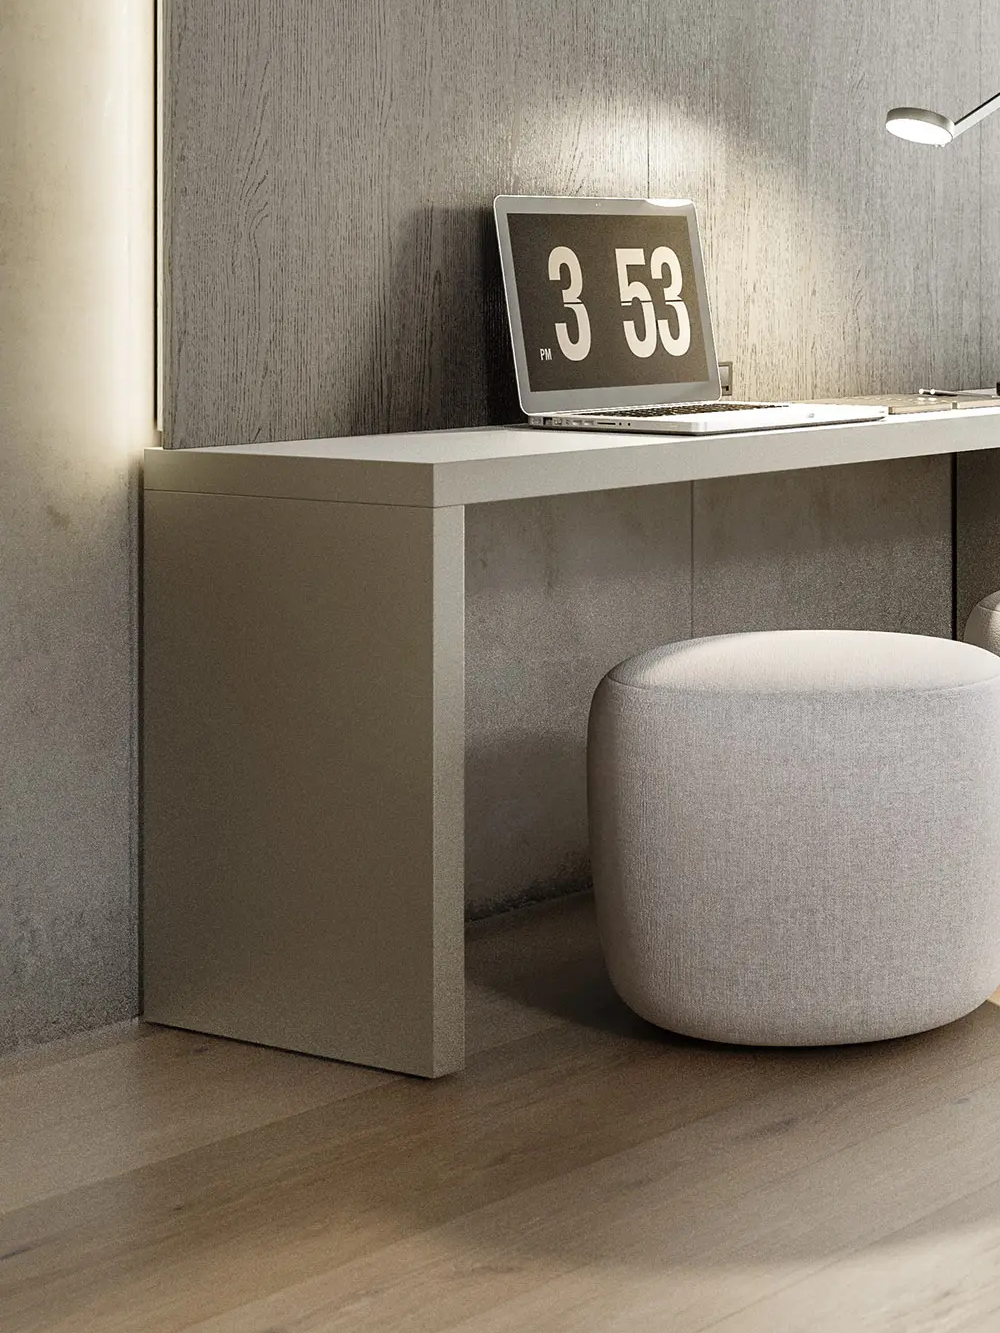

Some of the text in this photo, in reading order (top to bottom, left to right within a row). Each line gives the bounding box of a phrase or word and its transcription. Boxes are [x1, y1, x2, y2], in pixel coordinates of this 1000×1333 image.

[548, 246, 691, 361] 3 53
[540, 348, 552, 361] PM
